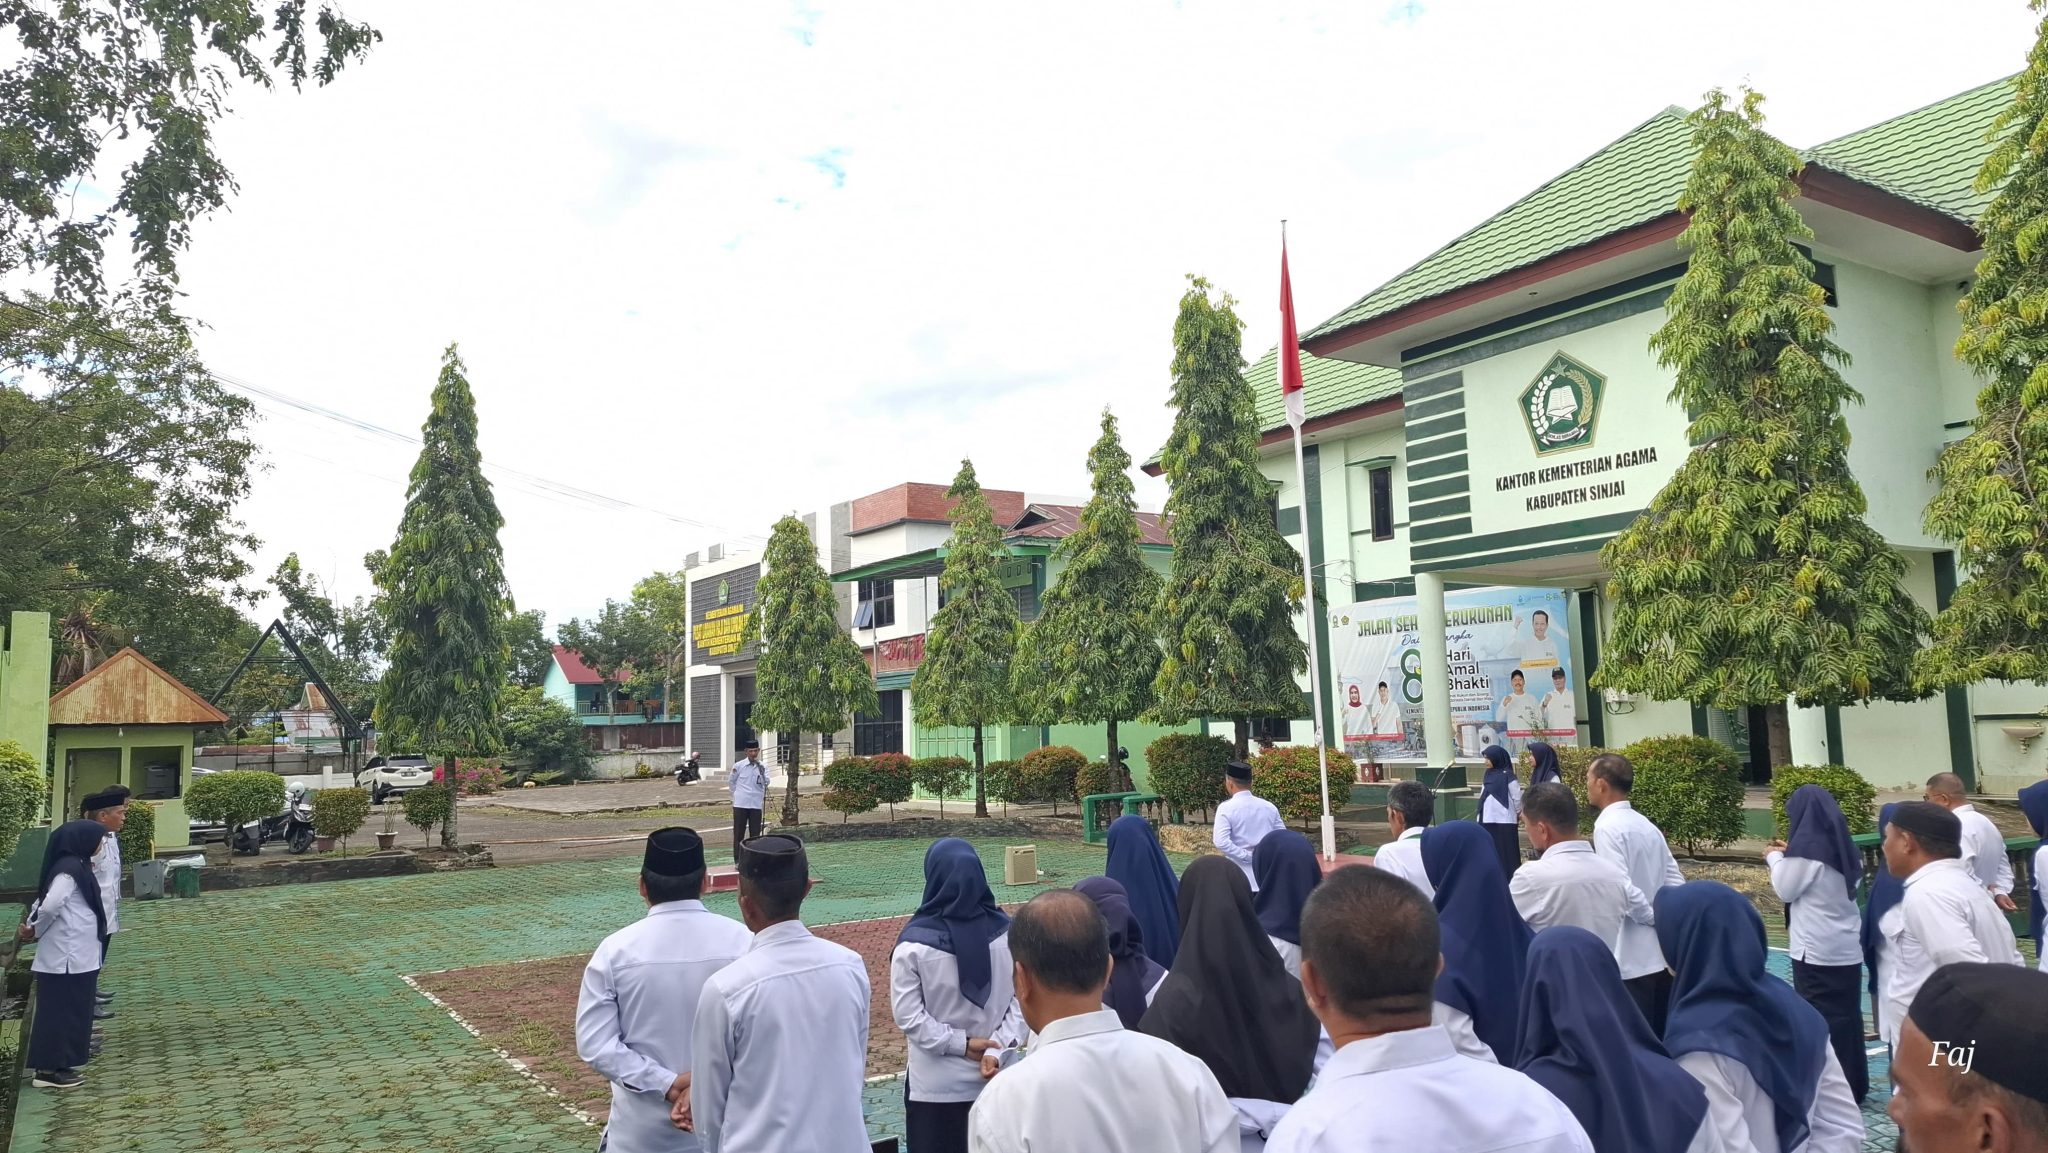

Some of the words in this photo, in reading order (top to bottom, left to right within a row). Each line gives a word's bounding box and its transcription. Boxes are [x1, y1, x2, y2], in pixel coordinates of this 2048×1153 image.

[1496, 471, 1536, 492] KANTOR
[1538, 456, 1612, 484] KEMENTERIAN
[1616, 447, 1658, 469] AGAMA
[1526, 487, 1587, 512] KABUPATEN
[1590, 480, 1625, 501] SINJAI
[1358, 618, 1393, 637] JALAN
[1396, 614, 1418, 632] SEH
[1446, 605, 1513, 628] ERUKUNAN
